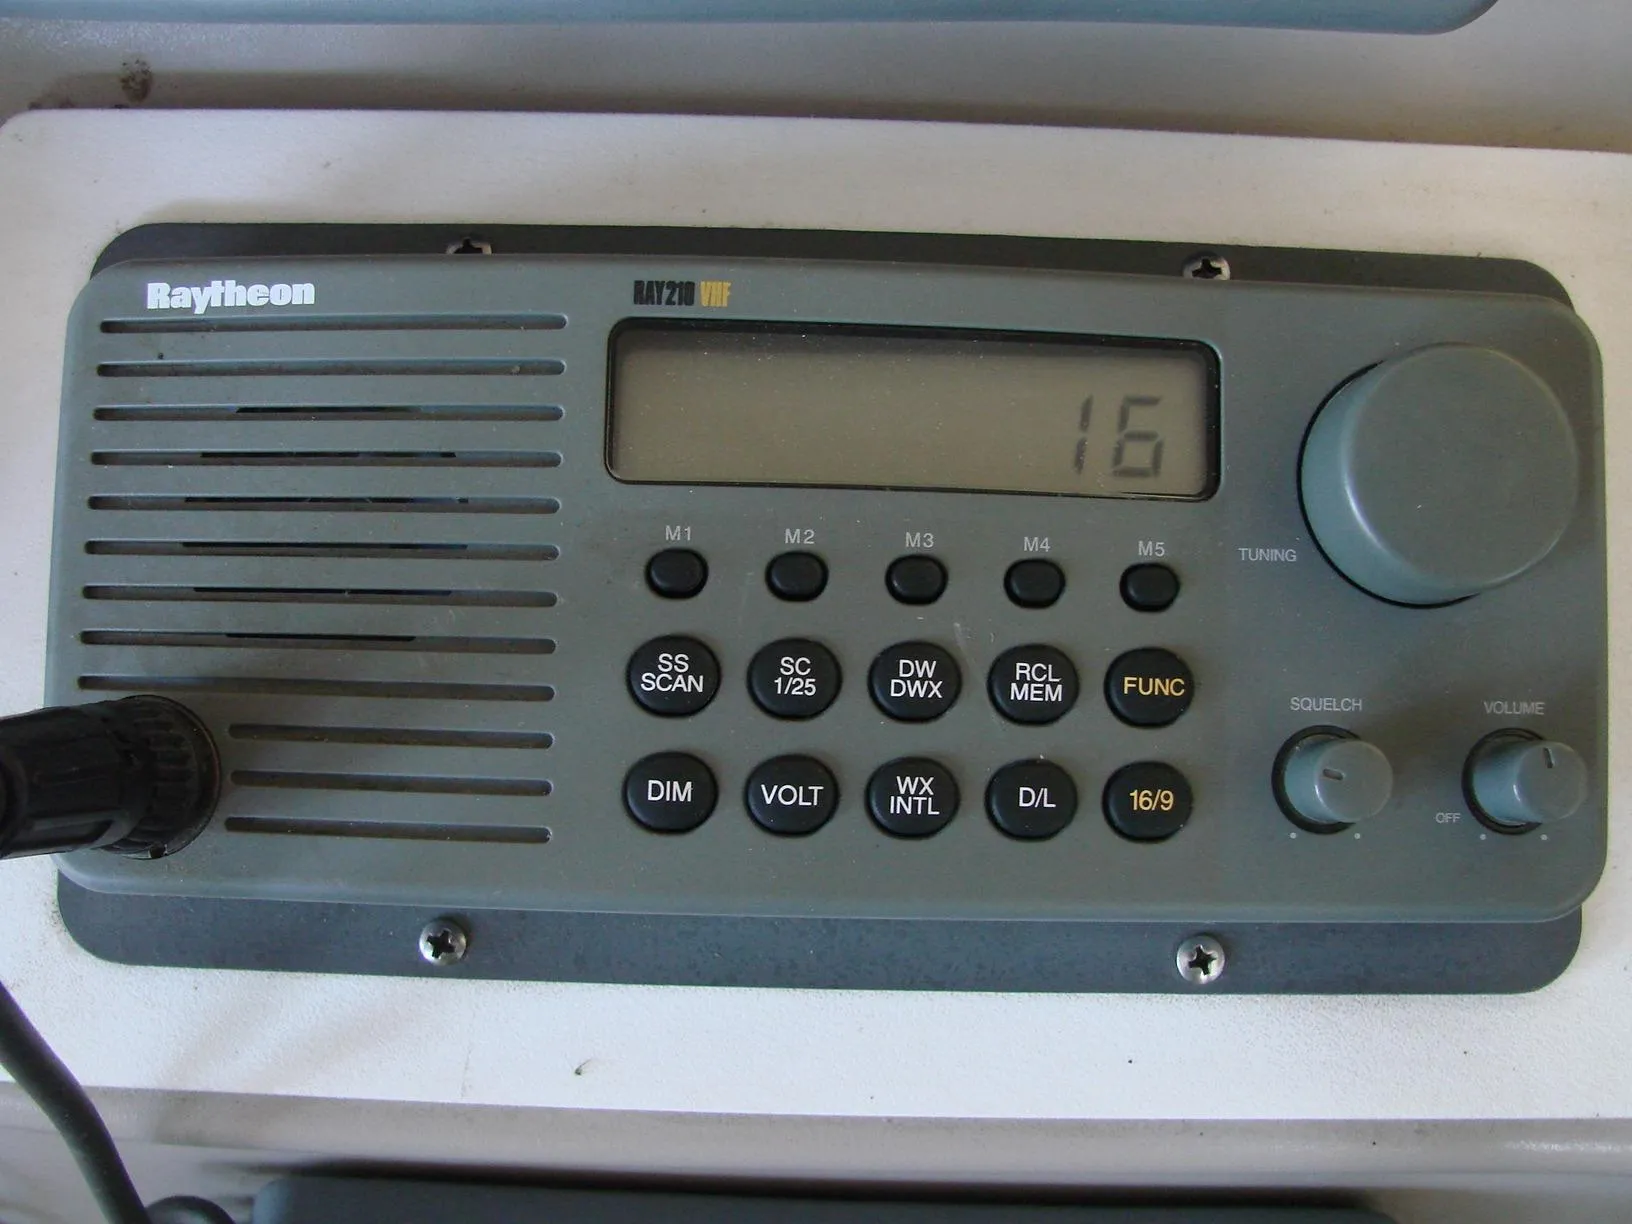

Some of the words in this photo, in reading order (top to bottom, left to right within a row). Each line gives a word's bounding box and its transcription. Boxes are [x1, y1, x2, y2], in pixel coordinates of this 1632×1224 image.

[147, 280, 315, 314] Raytheon
[700, 280, 731, 307] VHF
[1073, 395, 1163, 476] 16
[666, 525, 692, 541] M1
[785, 528, 815, 545] M2
[905, 532, 935, 549] M3
[1023, 536, 1051, 553] M4
[1138, 541, 1166, 557] M5
[1238, 547, 1297, 562] TUNING
[657, 653, 689, 672] SS
[779, 656, 812, 675] SC
[898, 659, 937, 678] DW
[1015, 662, 1061, 682] RCL
[640, 672, 704, 693] SCAN
[773, 677, 817, 696] 1/25
[889, 679, 943, 699] DWX
[1010, 682, 1063, 702] MEM
[1122, 676, 1186, 696] FUNC
[1290, 697, 1363, 713] SQUELCH
[1483, 701, 1546, 717] VOLUME
[647, 780, 692, 802] DIM
[896, 776, 934, 795] WX
[761, 785, 823, 806] VOLT
[1018, 787, 1057, 808] D/L
[1129, 790, 1175, 811] 16/9
[889, 796, 940, 815] INTL
[1435, 812, 1461, 825] OFF
